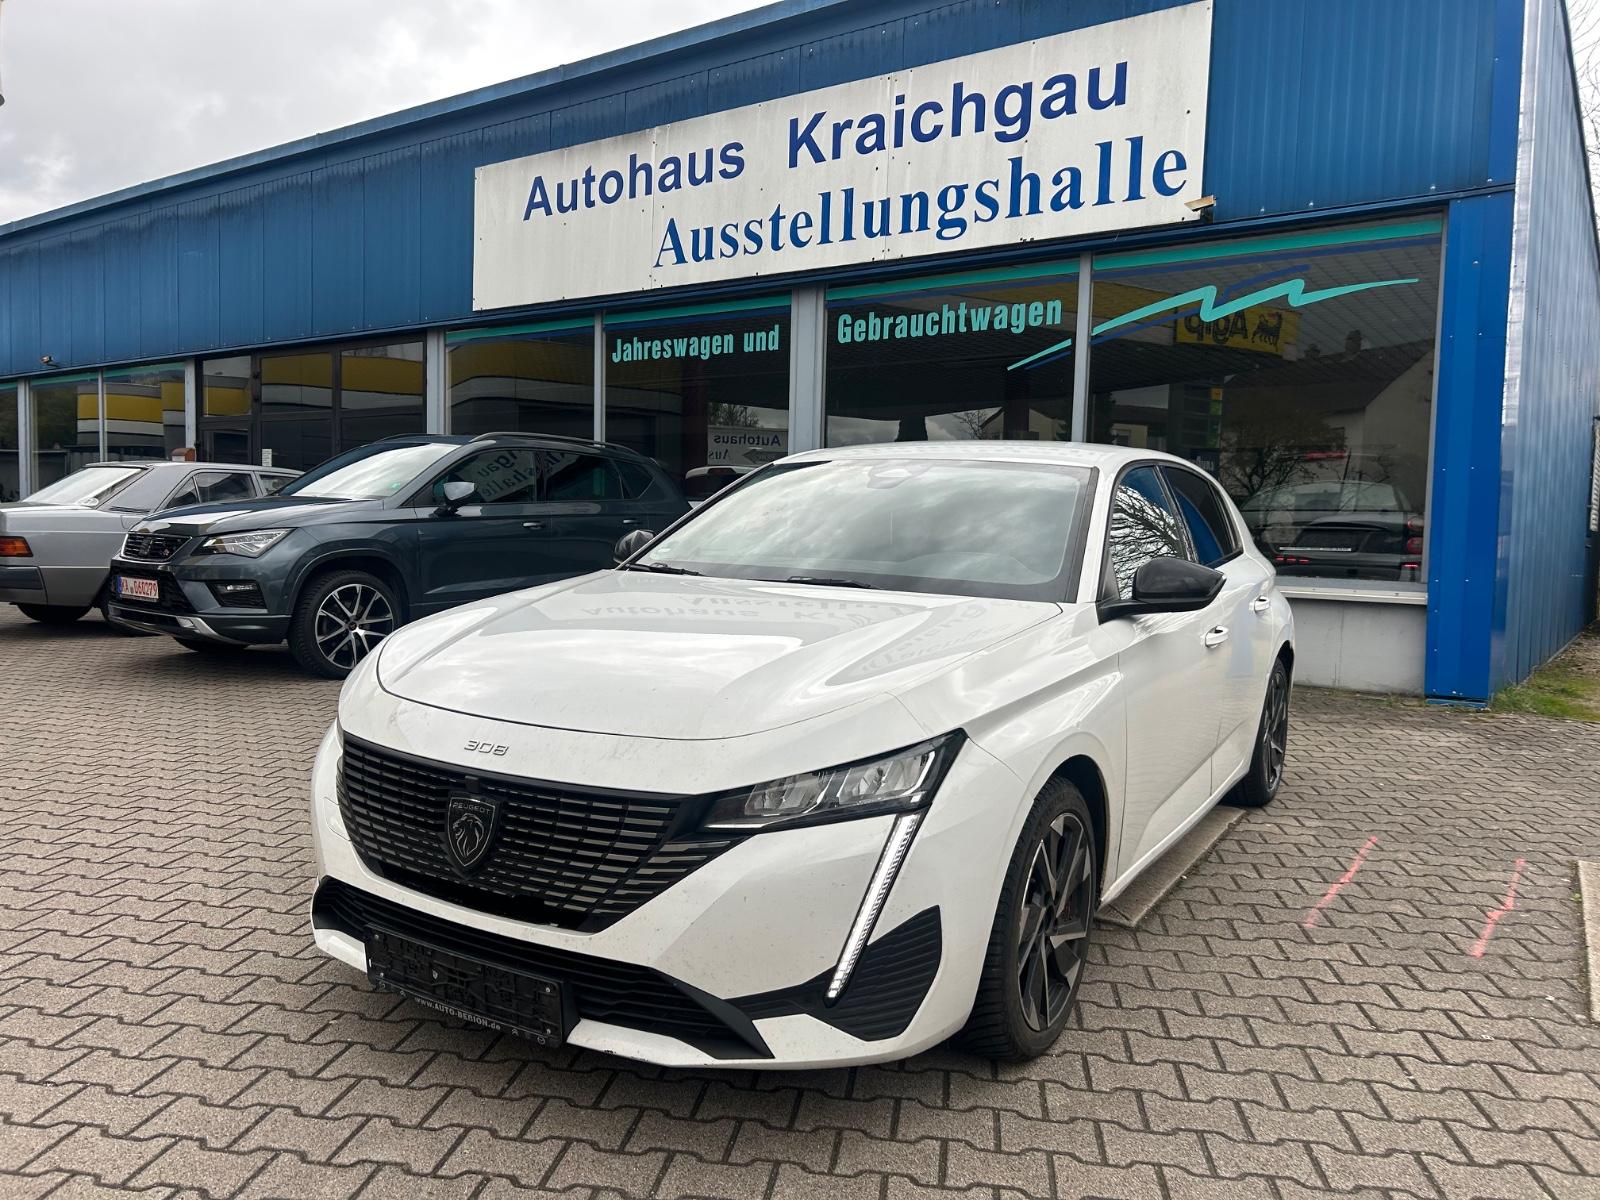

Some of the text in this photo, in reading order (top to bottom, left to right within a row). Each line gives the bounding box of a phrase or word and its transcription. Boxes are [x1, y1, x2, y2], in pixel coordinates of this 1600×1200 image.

[523, 61, 1129, 221] Autohaus Kraichgau
[652, 135, 1190, 269] Ausstellungshalle
[837, 299, 1063, 344] Gebrauchtwagen
[611, 325, 780, 363] Jahreswagen und
[463, 740, 510, 756] 308
[452, 802, 493, 815] PEUGEOT
